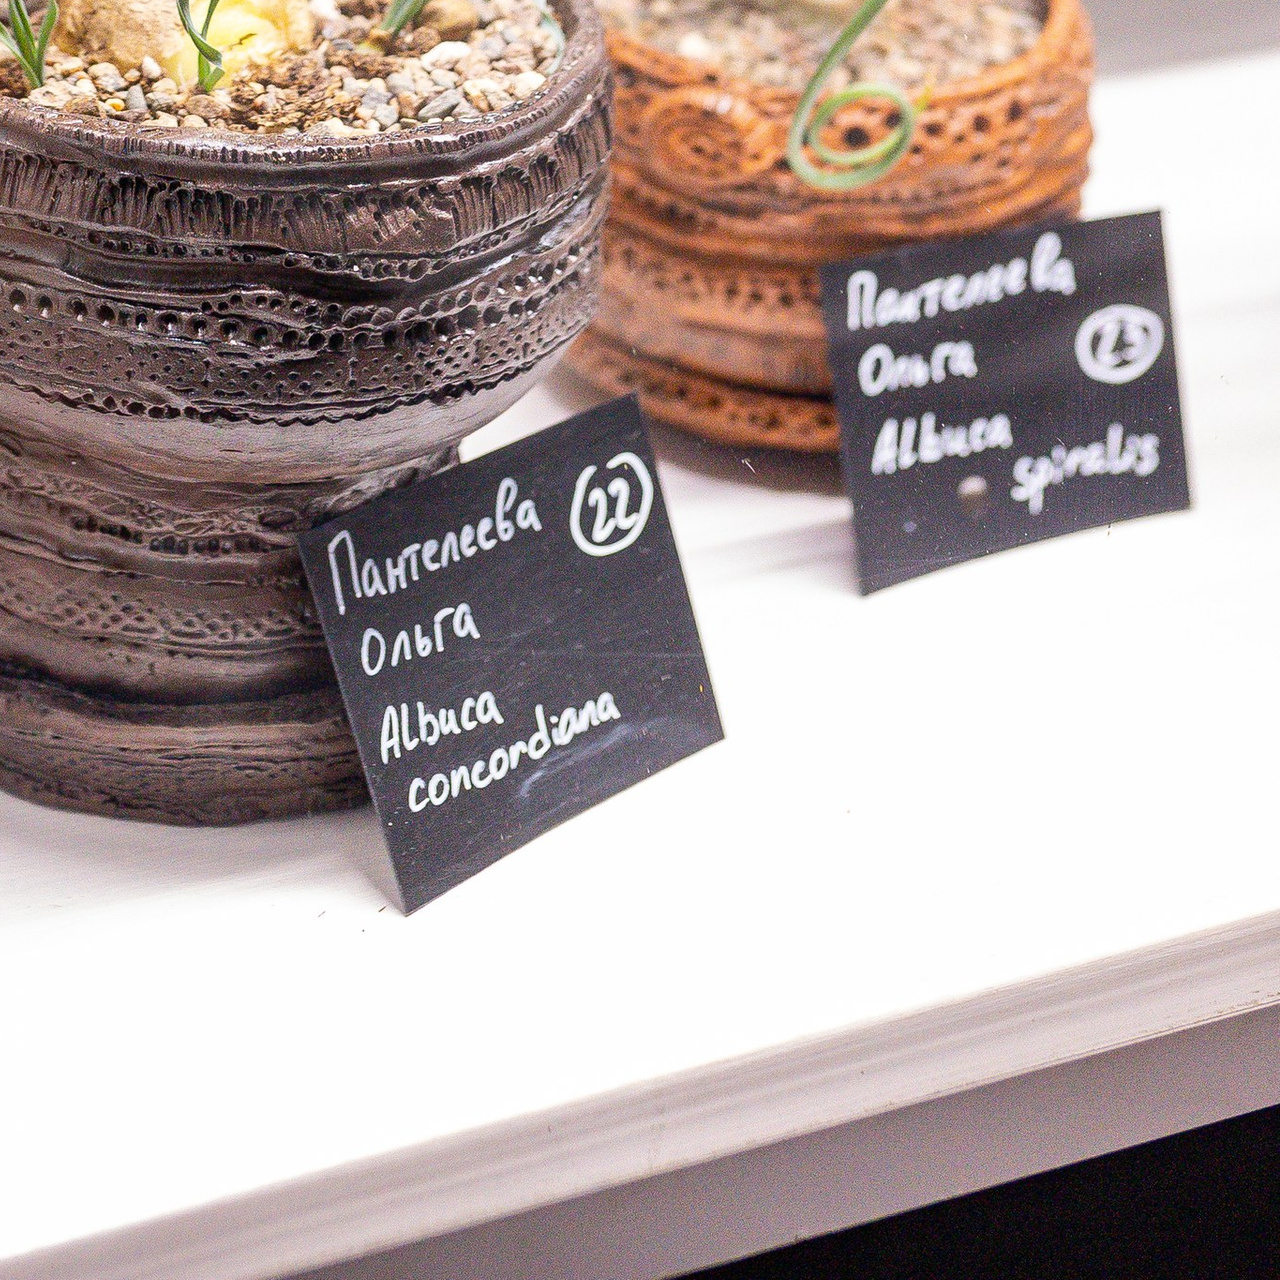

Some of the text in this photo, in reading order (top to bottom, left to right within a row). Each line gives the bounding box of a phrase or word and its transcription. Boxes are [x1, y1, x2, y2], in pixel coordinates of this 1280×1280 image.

[587, 476, 641, 542] 22
[327, 478, 542, 615] Пантелеева
[360, 602, 481, 676] Ольга
[379, 690, 505, 764] Albuca
[407, 691, 622, 813] concordiana
